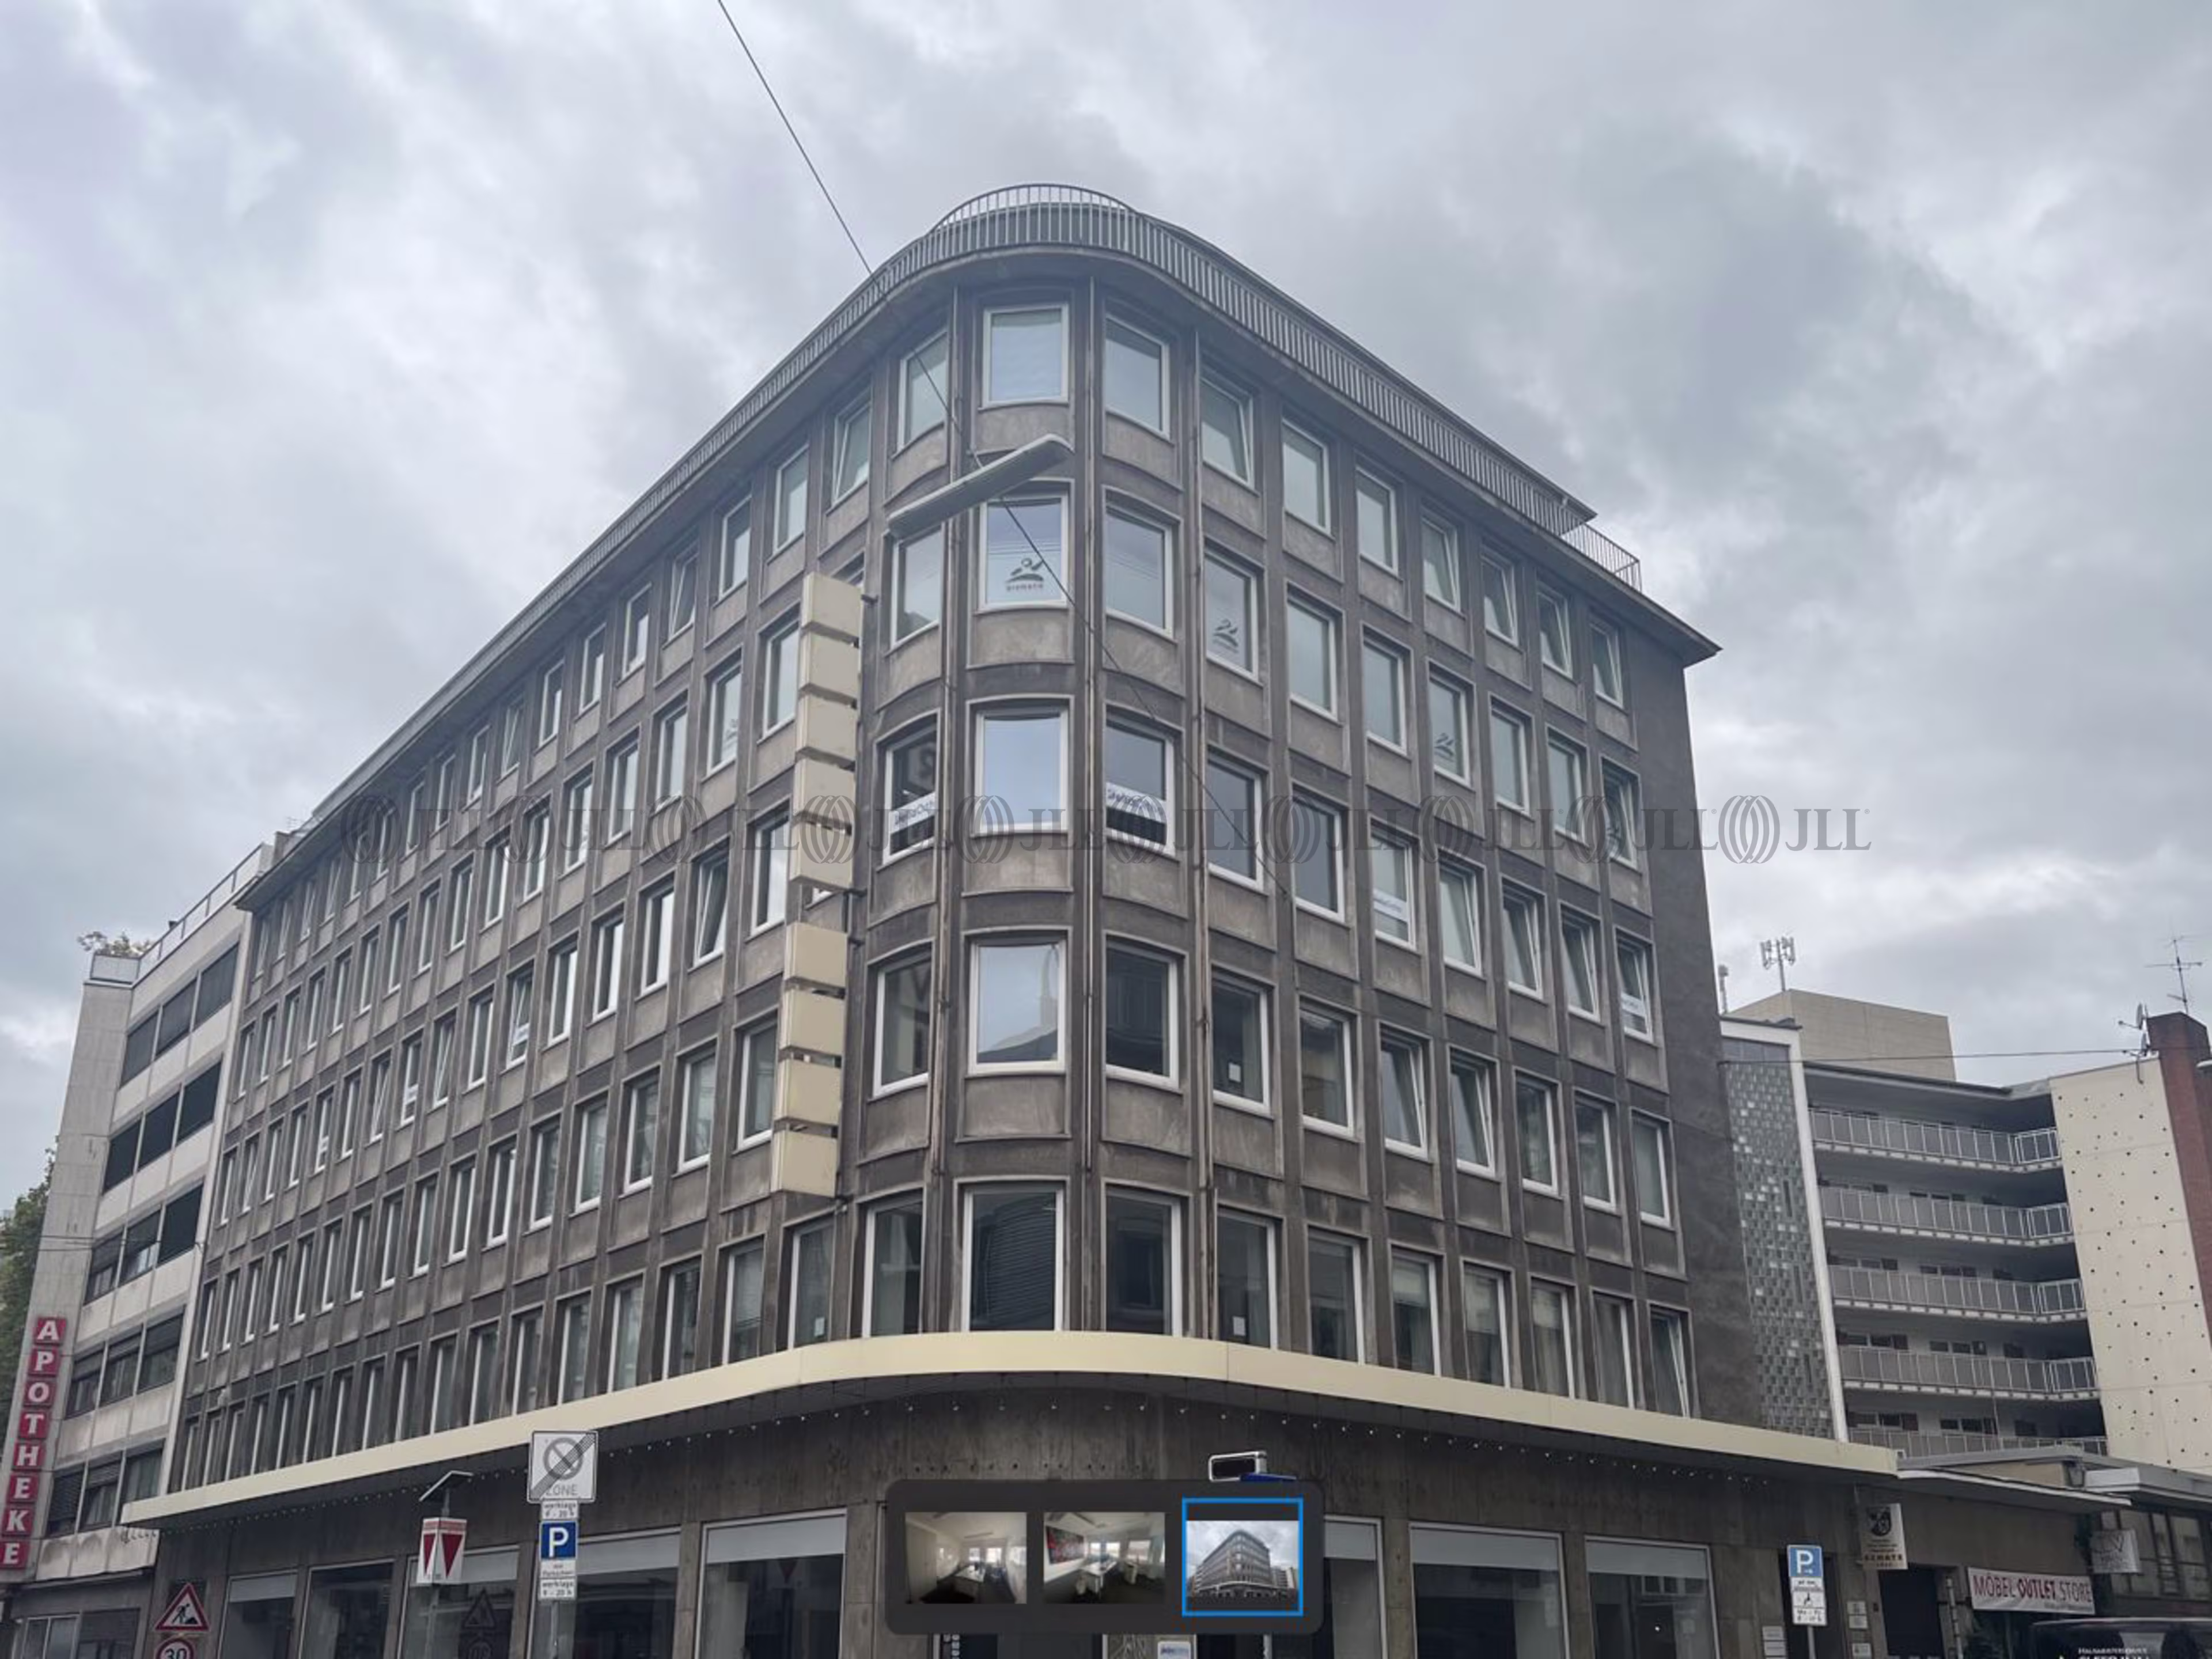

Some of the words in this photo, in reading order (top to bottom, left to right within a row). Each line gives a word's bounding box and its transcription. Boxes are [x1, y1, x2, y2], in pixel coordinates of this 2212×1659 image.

[3, 1320, 60, 1565] APOTHEKE
[549, 1527, 569, 1558] P
[1797, 1549, 1813, 1574] P
[1973, 1573, 2016, 1598] MÖBEL
[2018, 1577, 2056, 1600] OUTLET
[2059, 1581, 2092, 1603] STORE
